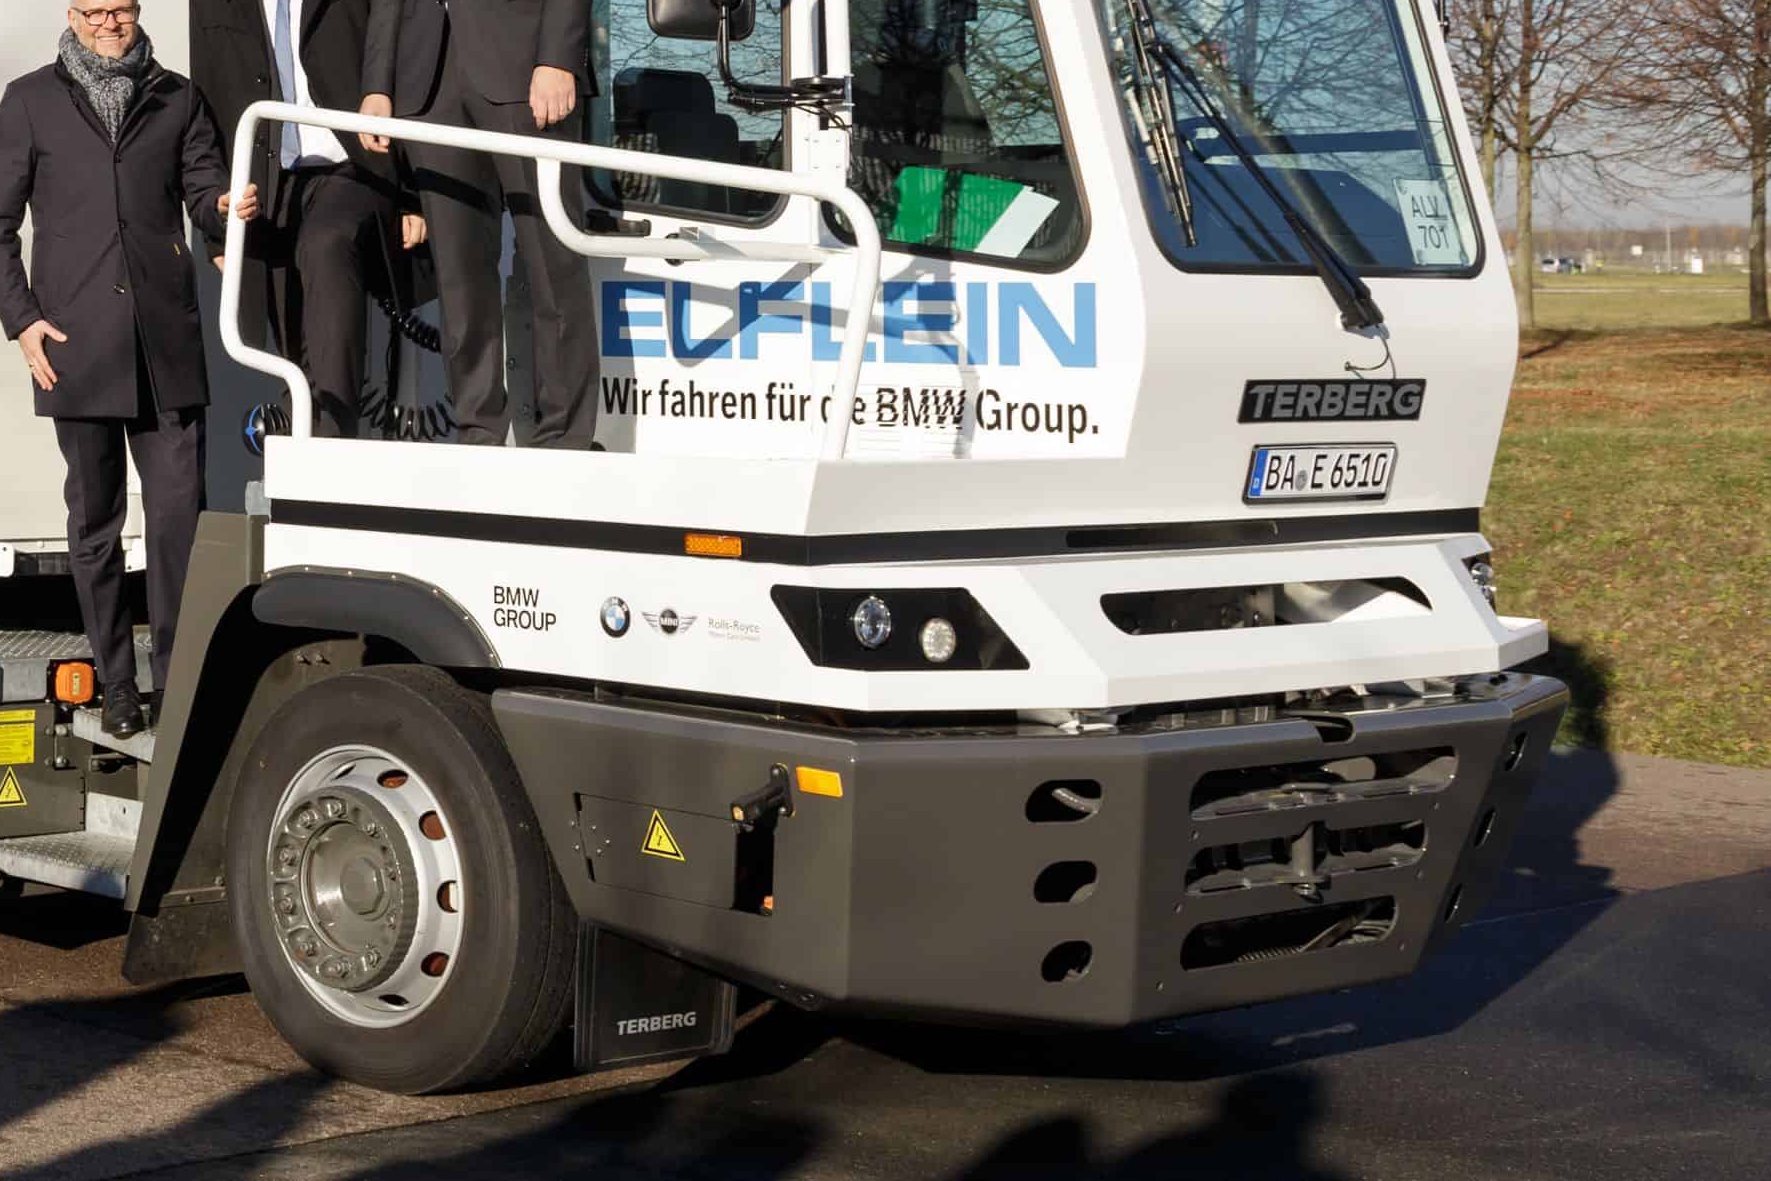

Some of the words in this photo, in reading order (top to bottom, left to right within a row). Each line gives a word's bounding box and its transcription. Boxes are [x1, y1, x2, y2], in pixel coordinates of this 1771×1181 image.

[1417, 224, 1450, 249] 701
[602, 281, 1097, 368] ELFLEIN
[602, 377, 652, 416] Wir
[659, 379, 757, 419] fahren
[766, 382, 811, 422] für
[876, 387, 967, 430] BMW
[976, 388, 1099, 444] Group.
[1248, 384, 1422, 419] TERBERG
[1265, 455, 1296, 490] BA
[1311, 454, 1328, 489] E
[1330, 453, 1388, 488] 6510
[493, 586, 539, 607] BMW
[493, 608, 557, 631] GROUP
[617, 1011, 697, 1036] TERBERG
